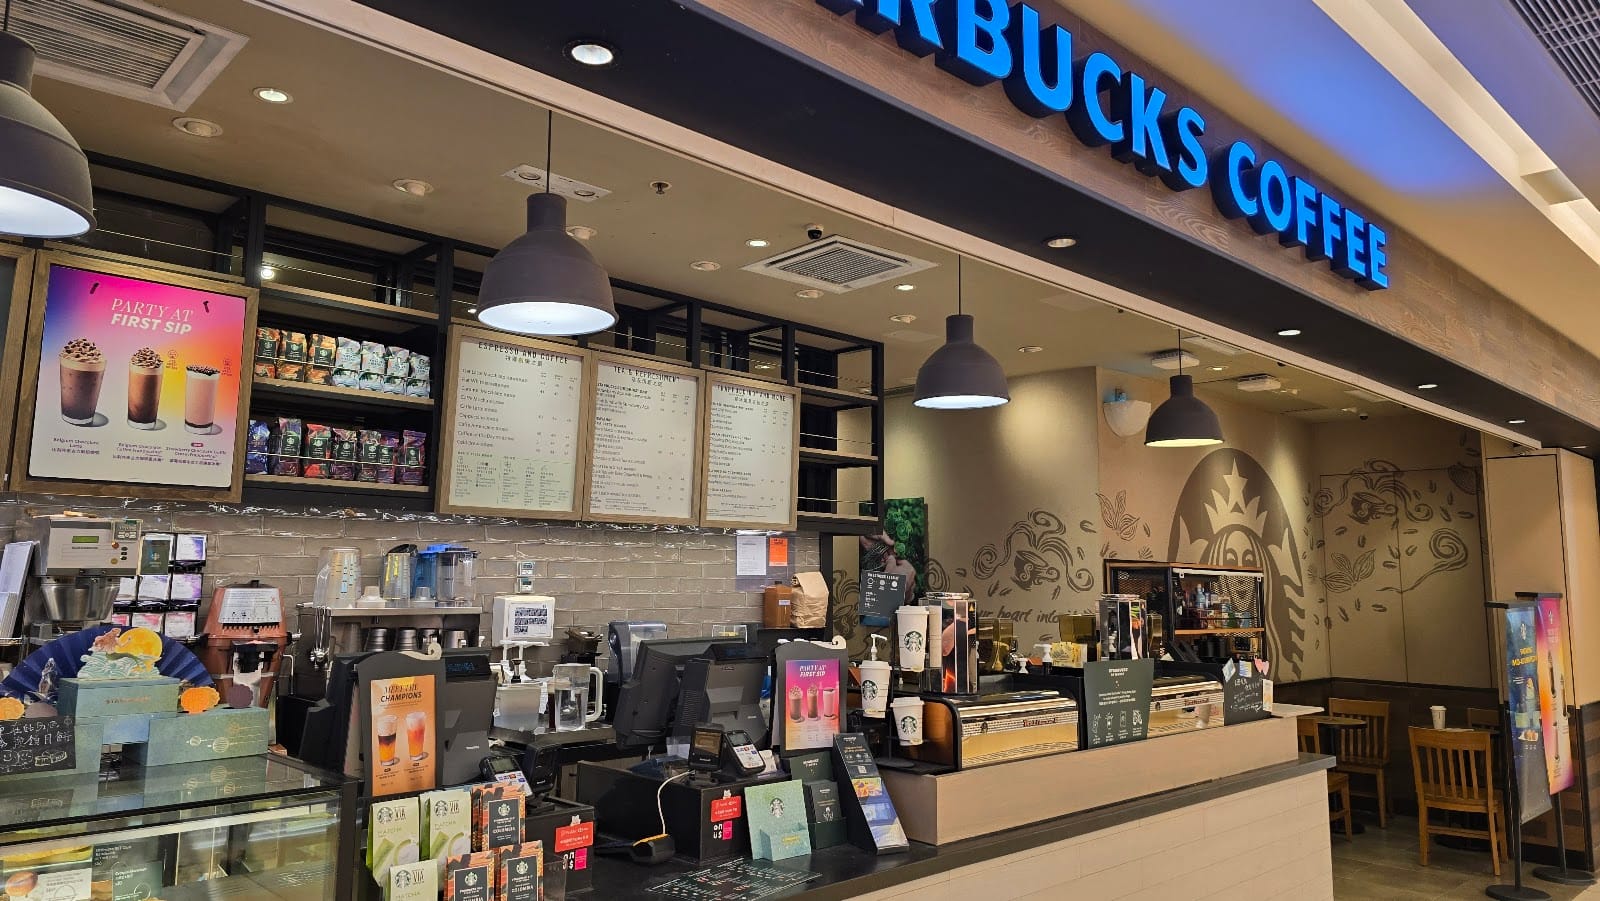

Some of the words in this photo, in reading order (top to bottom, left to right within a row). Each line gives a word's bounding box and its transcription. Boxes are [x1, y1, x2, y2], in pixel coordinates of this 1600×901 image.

[1228, 140, 1390, 290] COFFEE
[112, 298, 169, 317] PARTY
[171, 307, 194, 322] AT
[111, 313, 161, 330] FIRST
[163, 321, 192, 335] SIP
[478, 341, 519, 355] ESPRESSO
[522, 349, 537, 359] AND
[540, 352, 568, 365] COFFEE
[997, 605, 1033, 623] heart
[1037, 609, 1060, 624] into
[380, 691, 422, 703] CHAMPIONS
[394, 808, 406, 820] VIA
[449, 801, 460, 812] VIA
[412, 870, 424, 883] VIA
